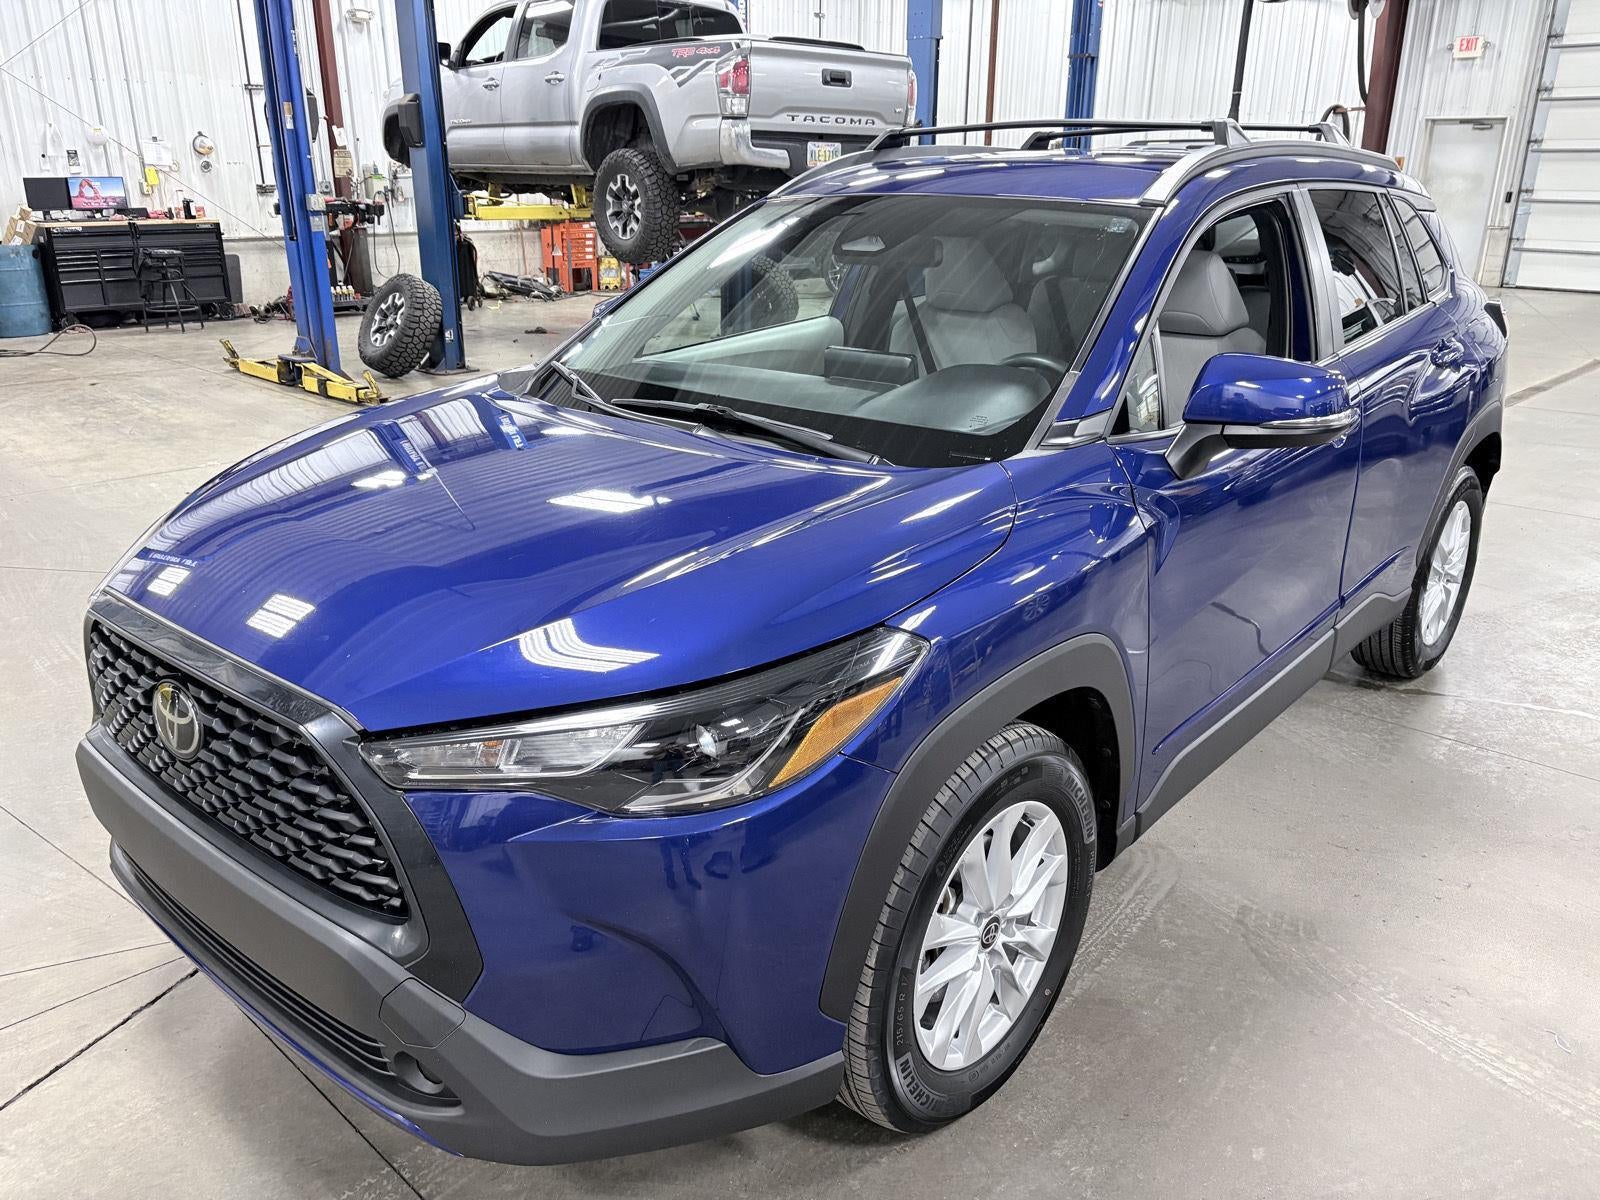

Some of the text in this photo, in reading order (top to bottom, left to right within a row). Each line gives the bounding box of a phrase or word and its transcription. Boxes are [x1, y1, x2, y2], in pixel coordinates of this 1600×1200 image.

[1459, 36, 1480, 51] EXIT
[671, 46, 720, 58] TRD 4x4
[786, 113, 876, 126] TACOMA
[1064, 774, 1095, 839] MICHELIN
[896, 1006, 905, 1045] 215/65
